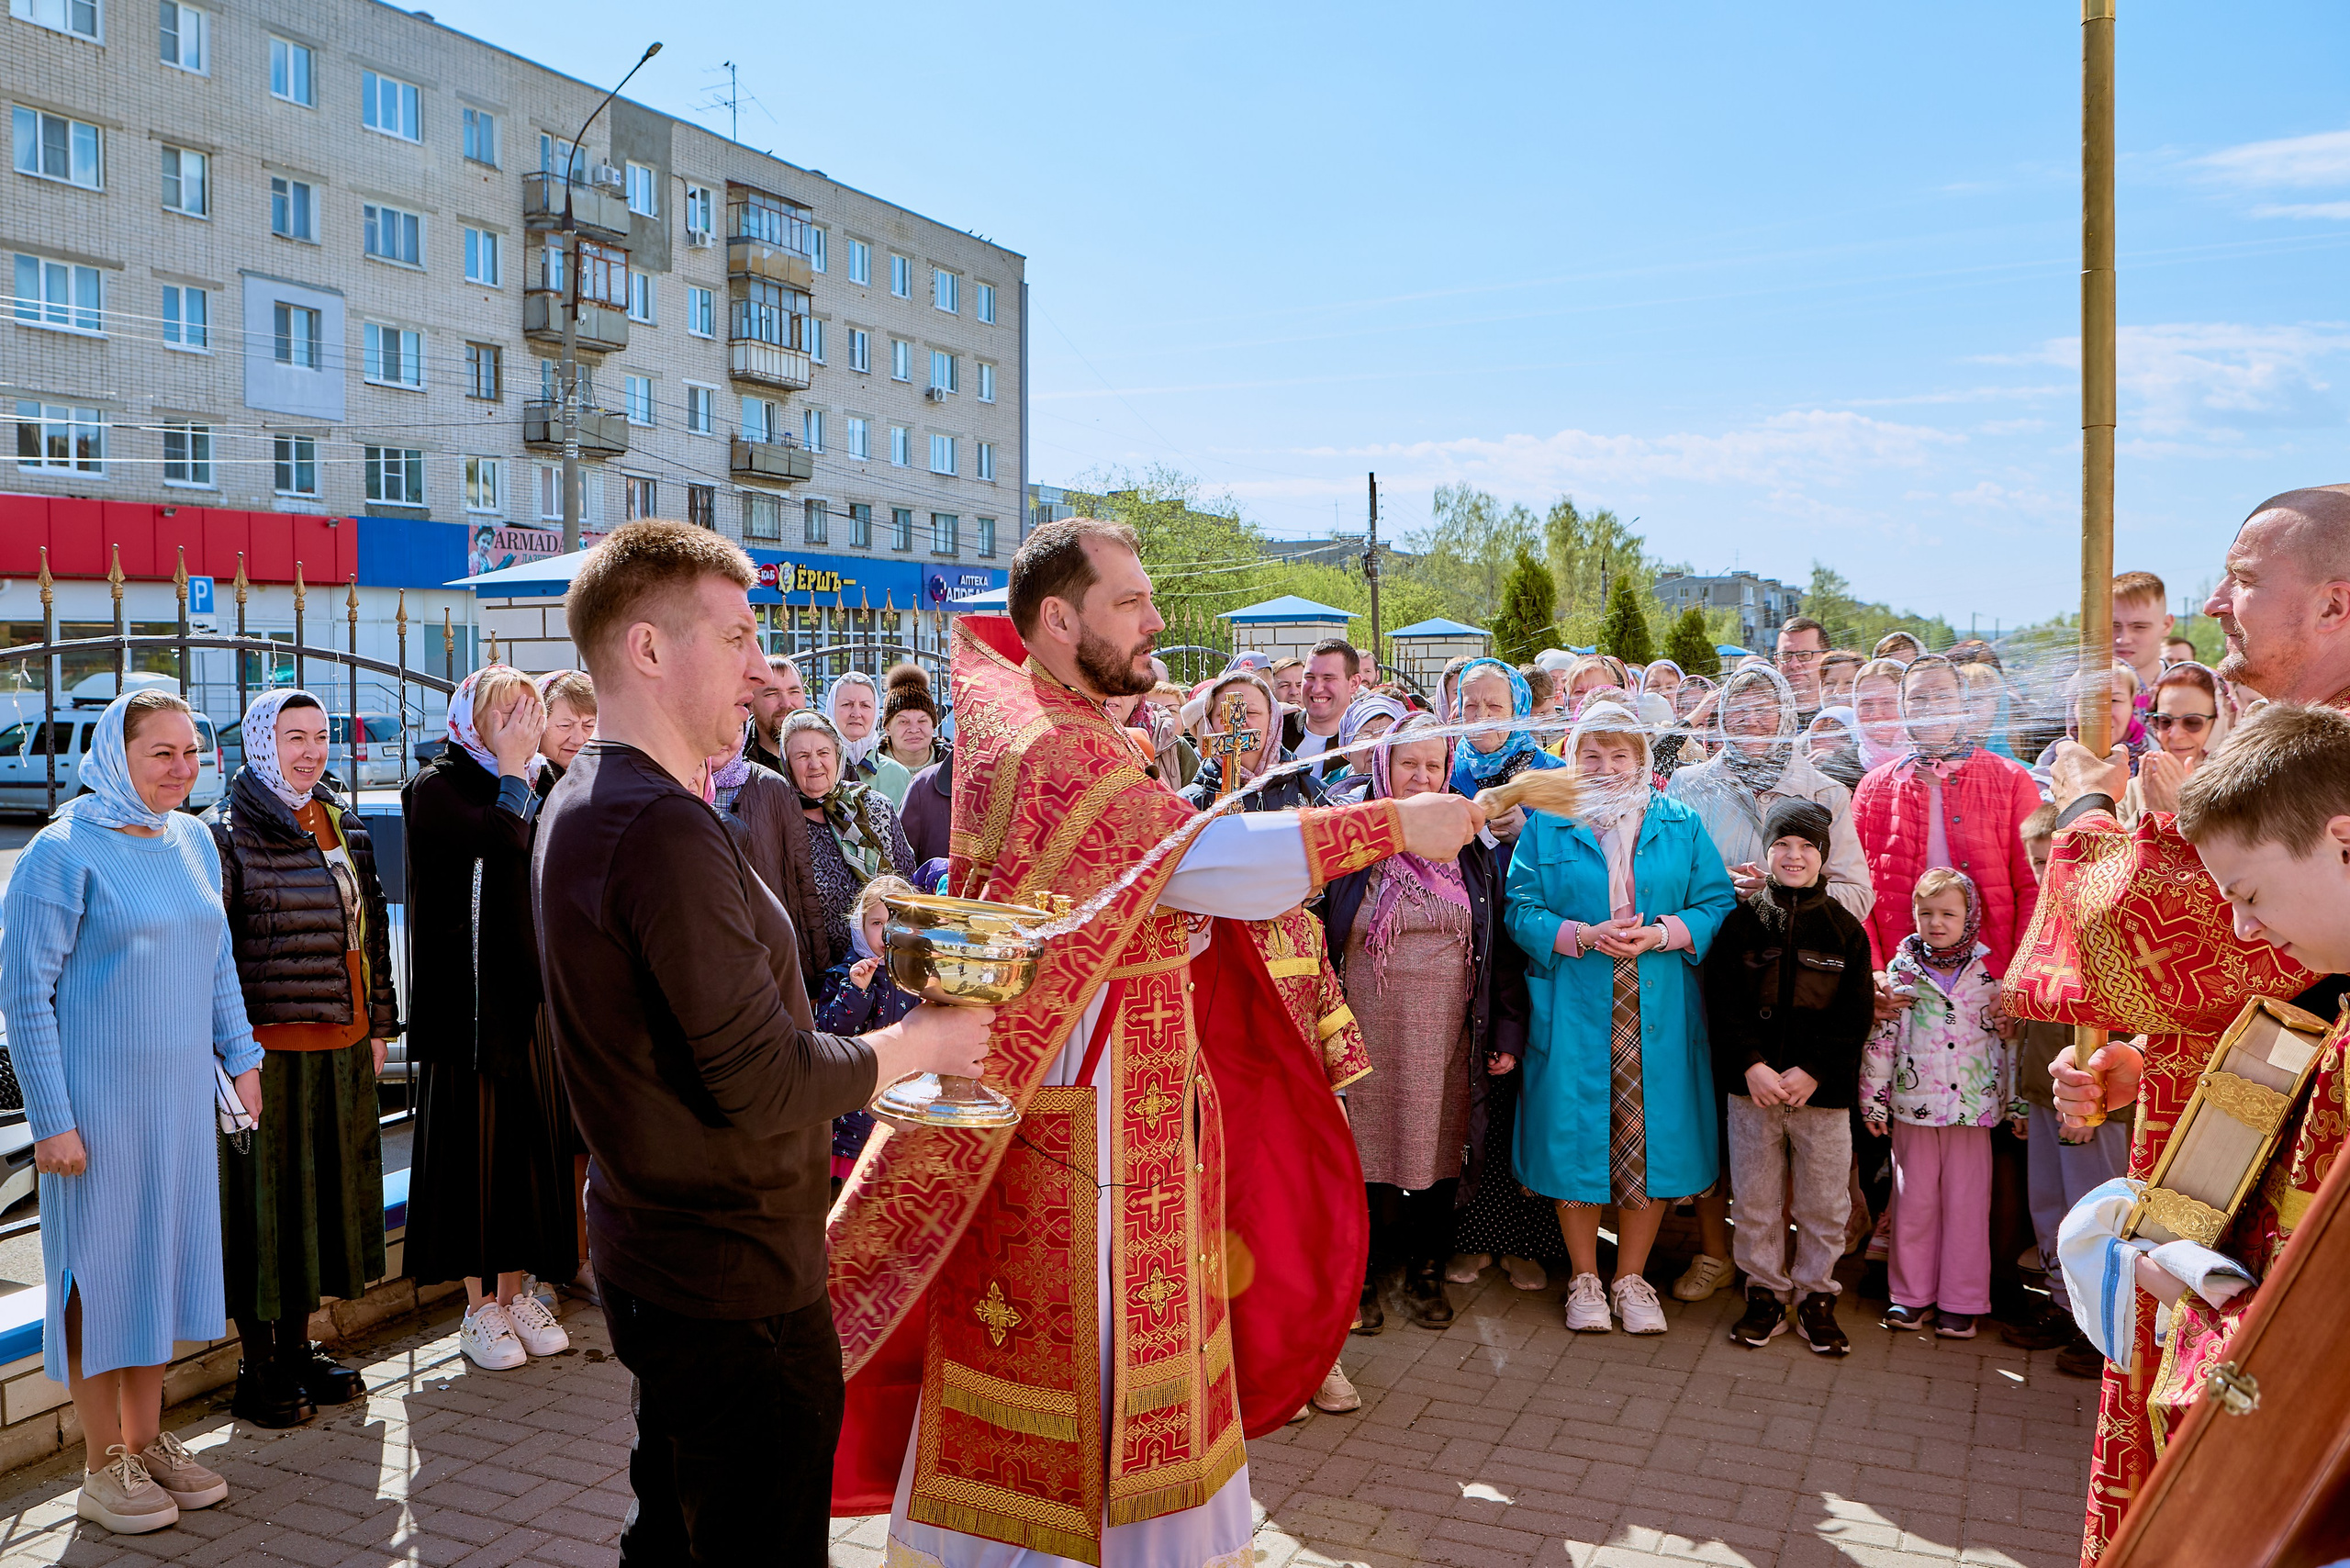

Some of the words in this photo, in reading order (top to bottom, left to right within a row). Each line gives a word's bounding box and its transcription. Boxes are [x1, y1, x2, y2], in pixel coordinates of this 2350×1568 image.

[960, 575, 989, 587] АПТЕКА
[195, 580, 208, 610] P
[946, 588, 984, 602] АПРЕ
